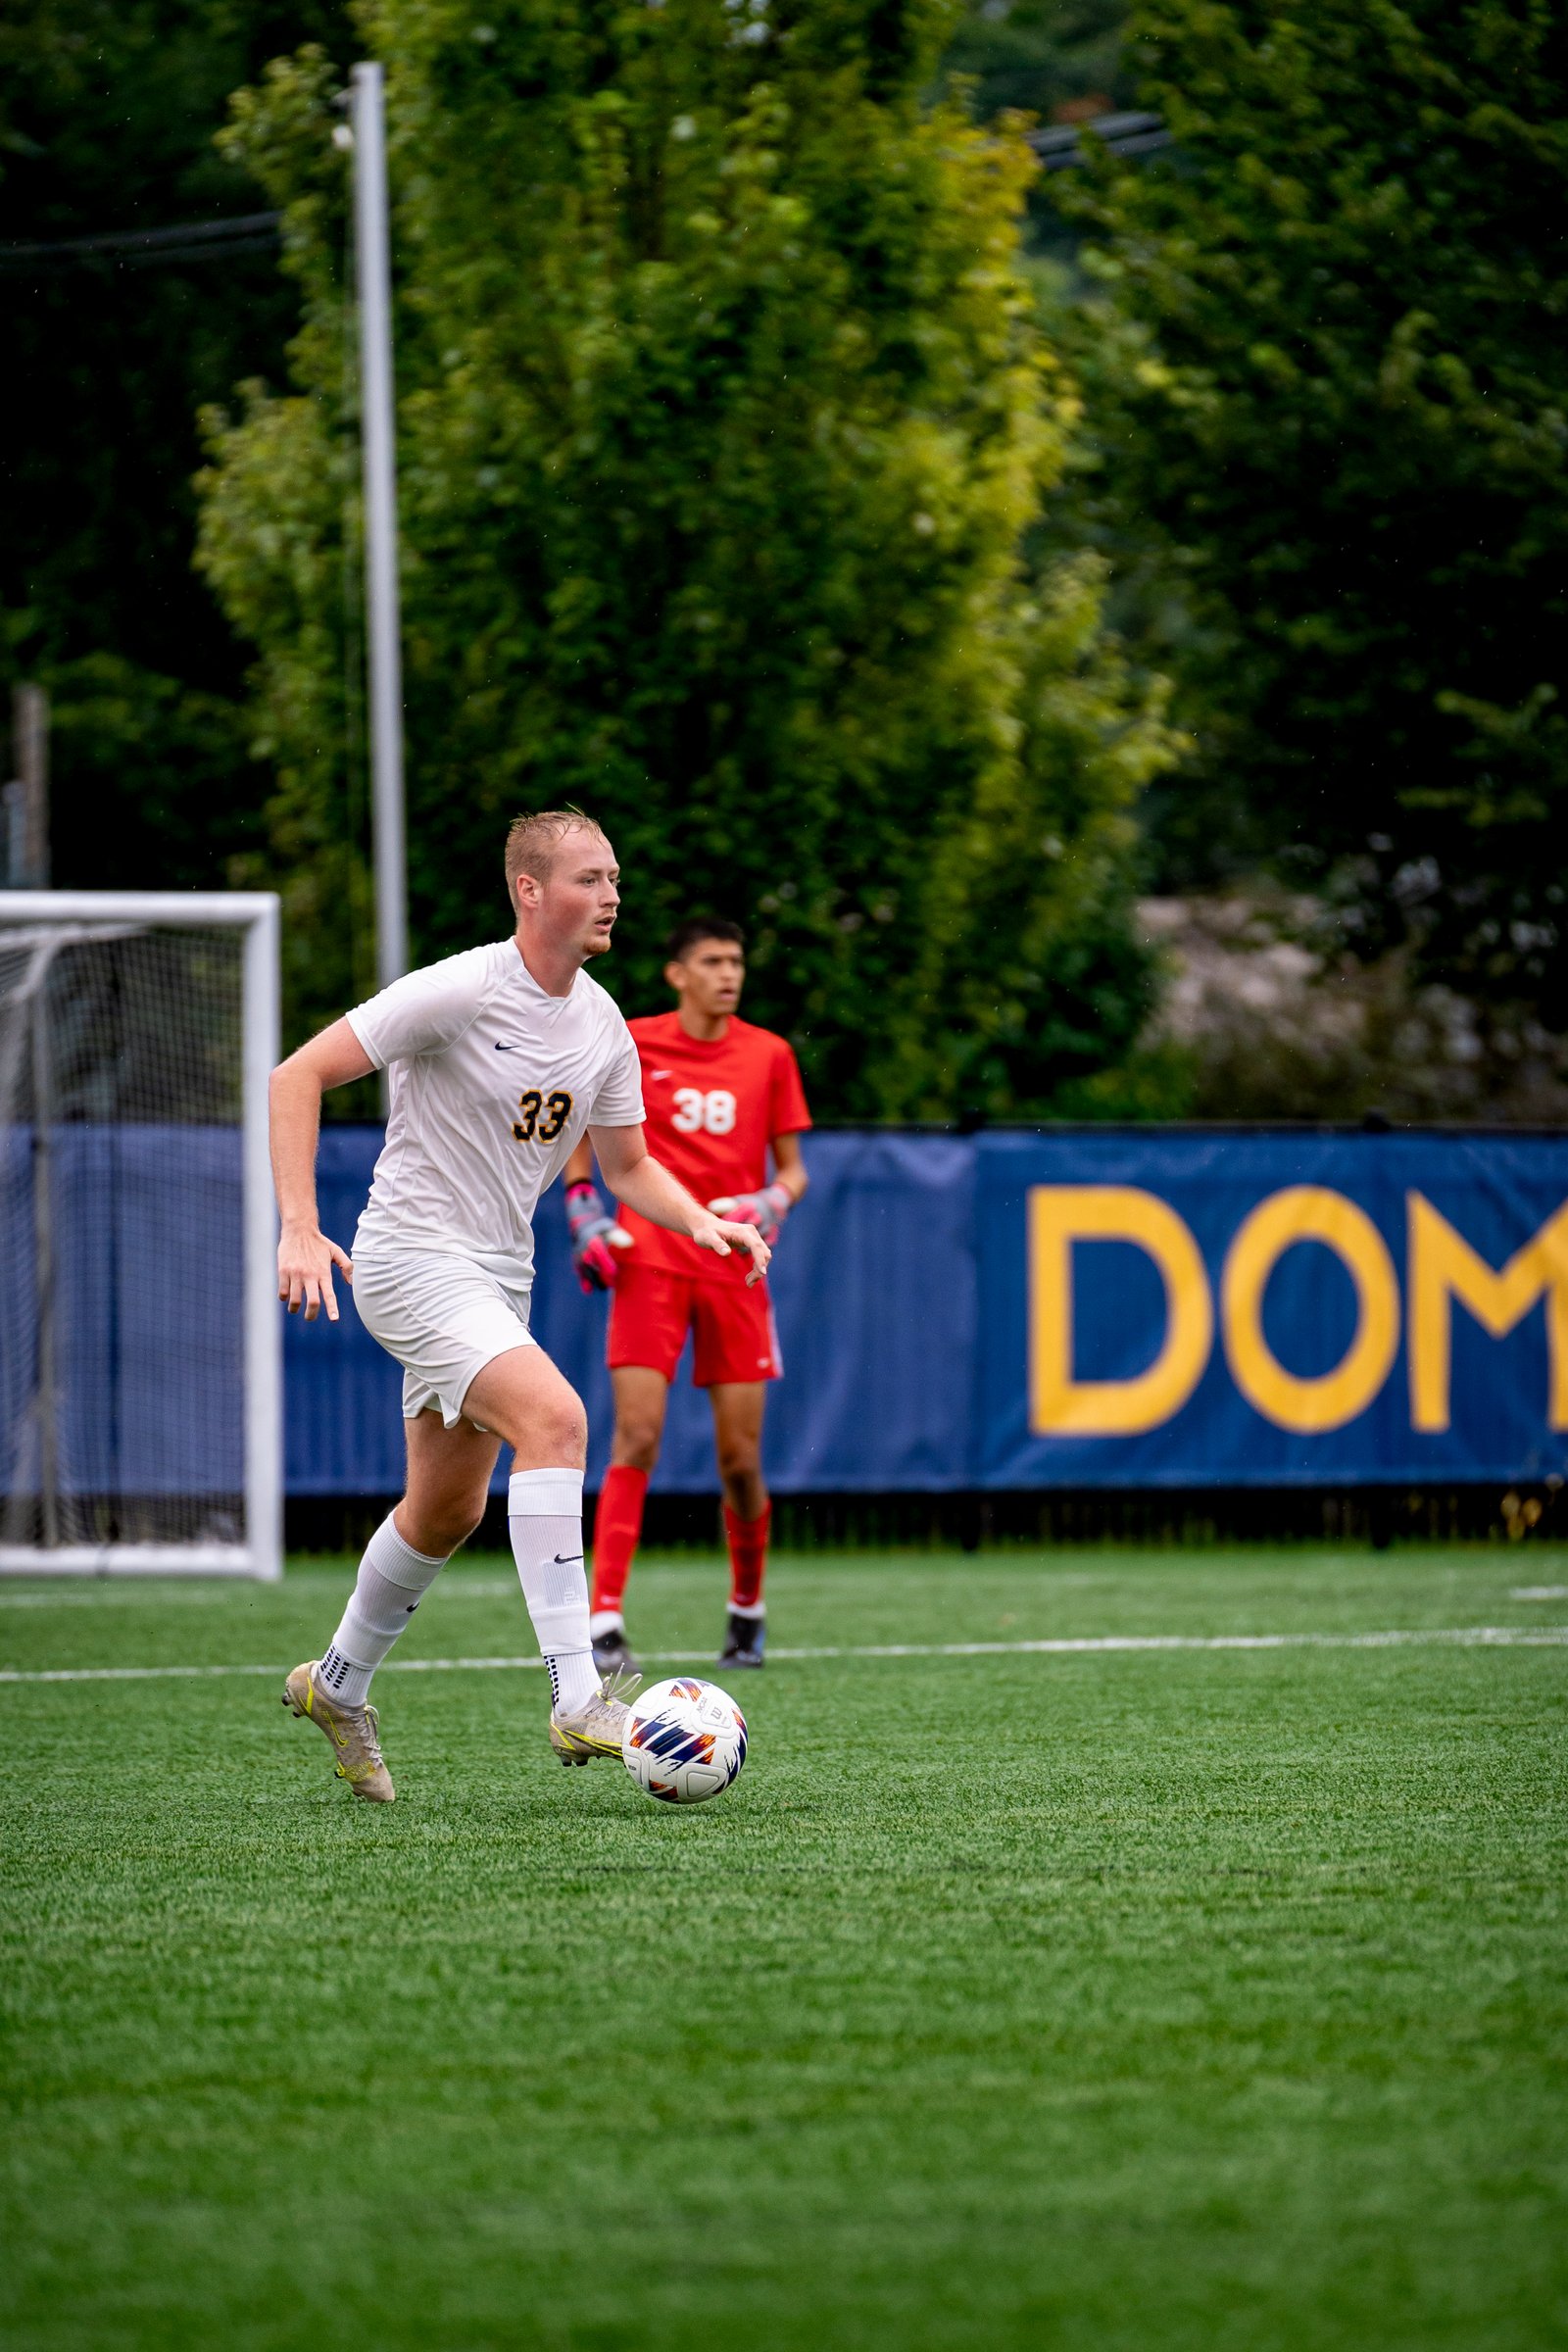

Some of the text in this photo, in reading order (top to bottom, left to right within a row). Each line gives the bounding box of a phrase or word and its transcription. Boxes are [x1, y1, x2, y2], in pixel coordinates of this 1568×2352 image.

[512, 1089, 574, 1145] 33
[671, 1088, 736, 1136] 38
[1027, 1184, 1568, 1436] DOM
